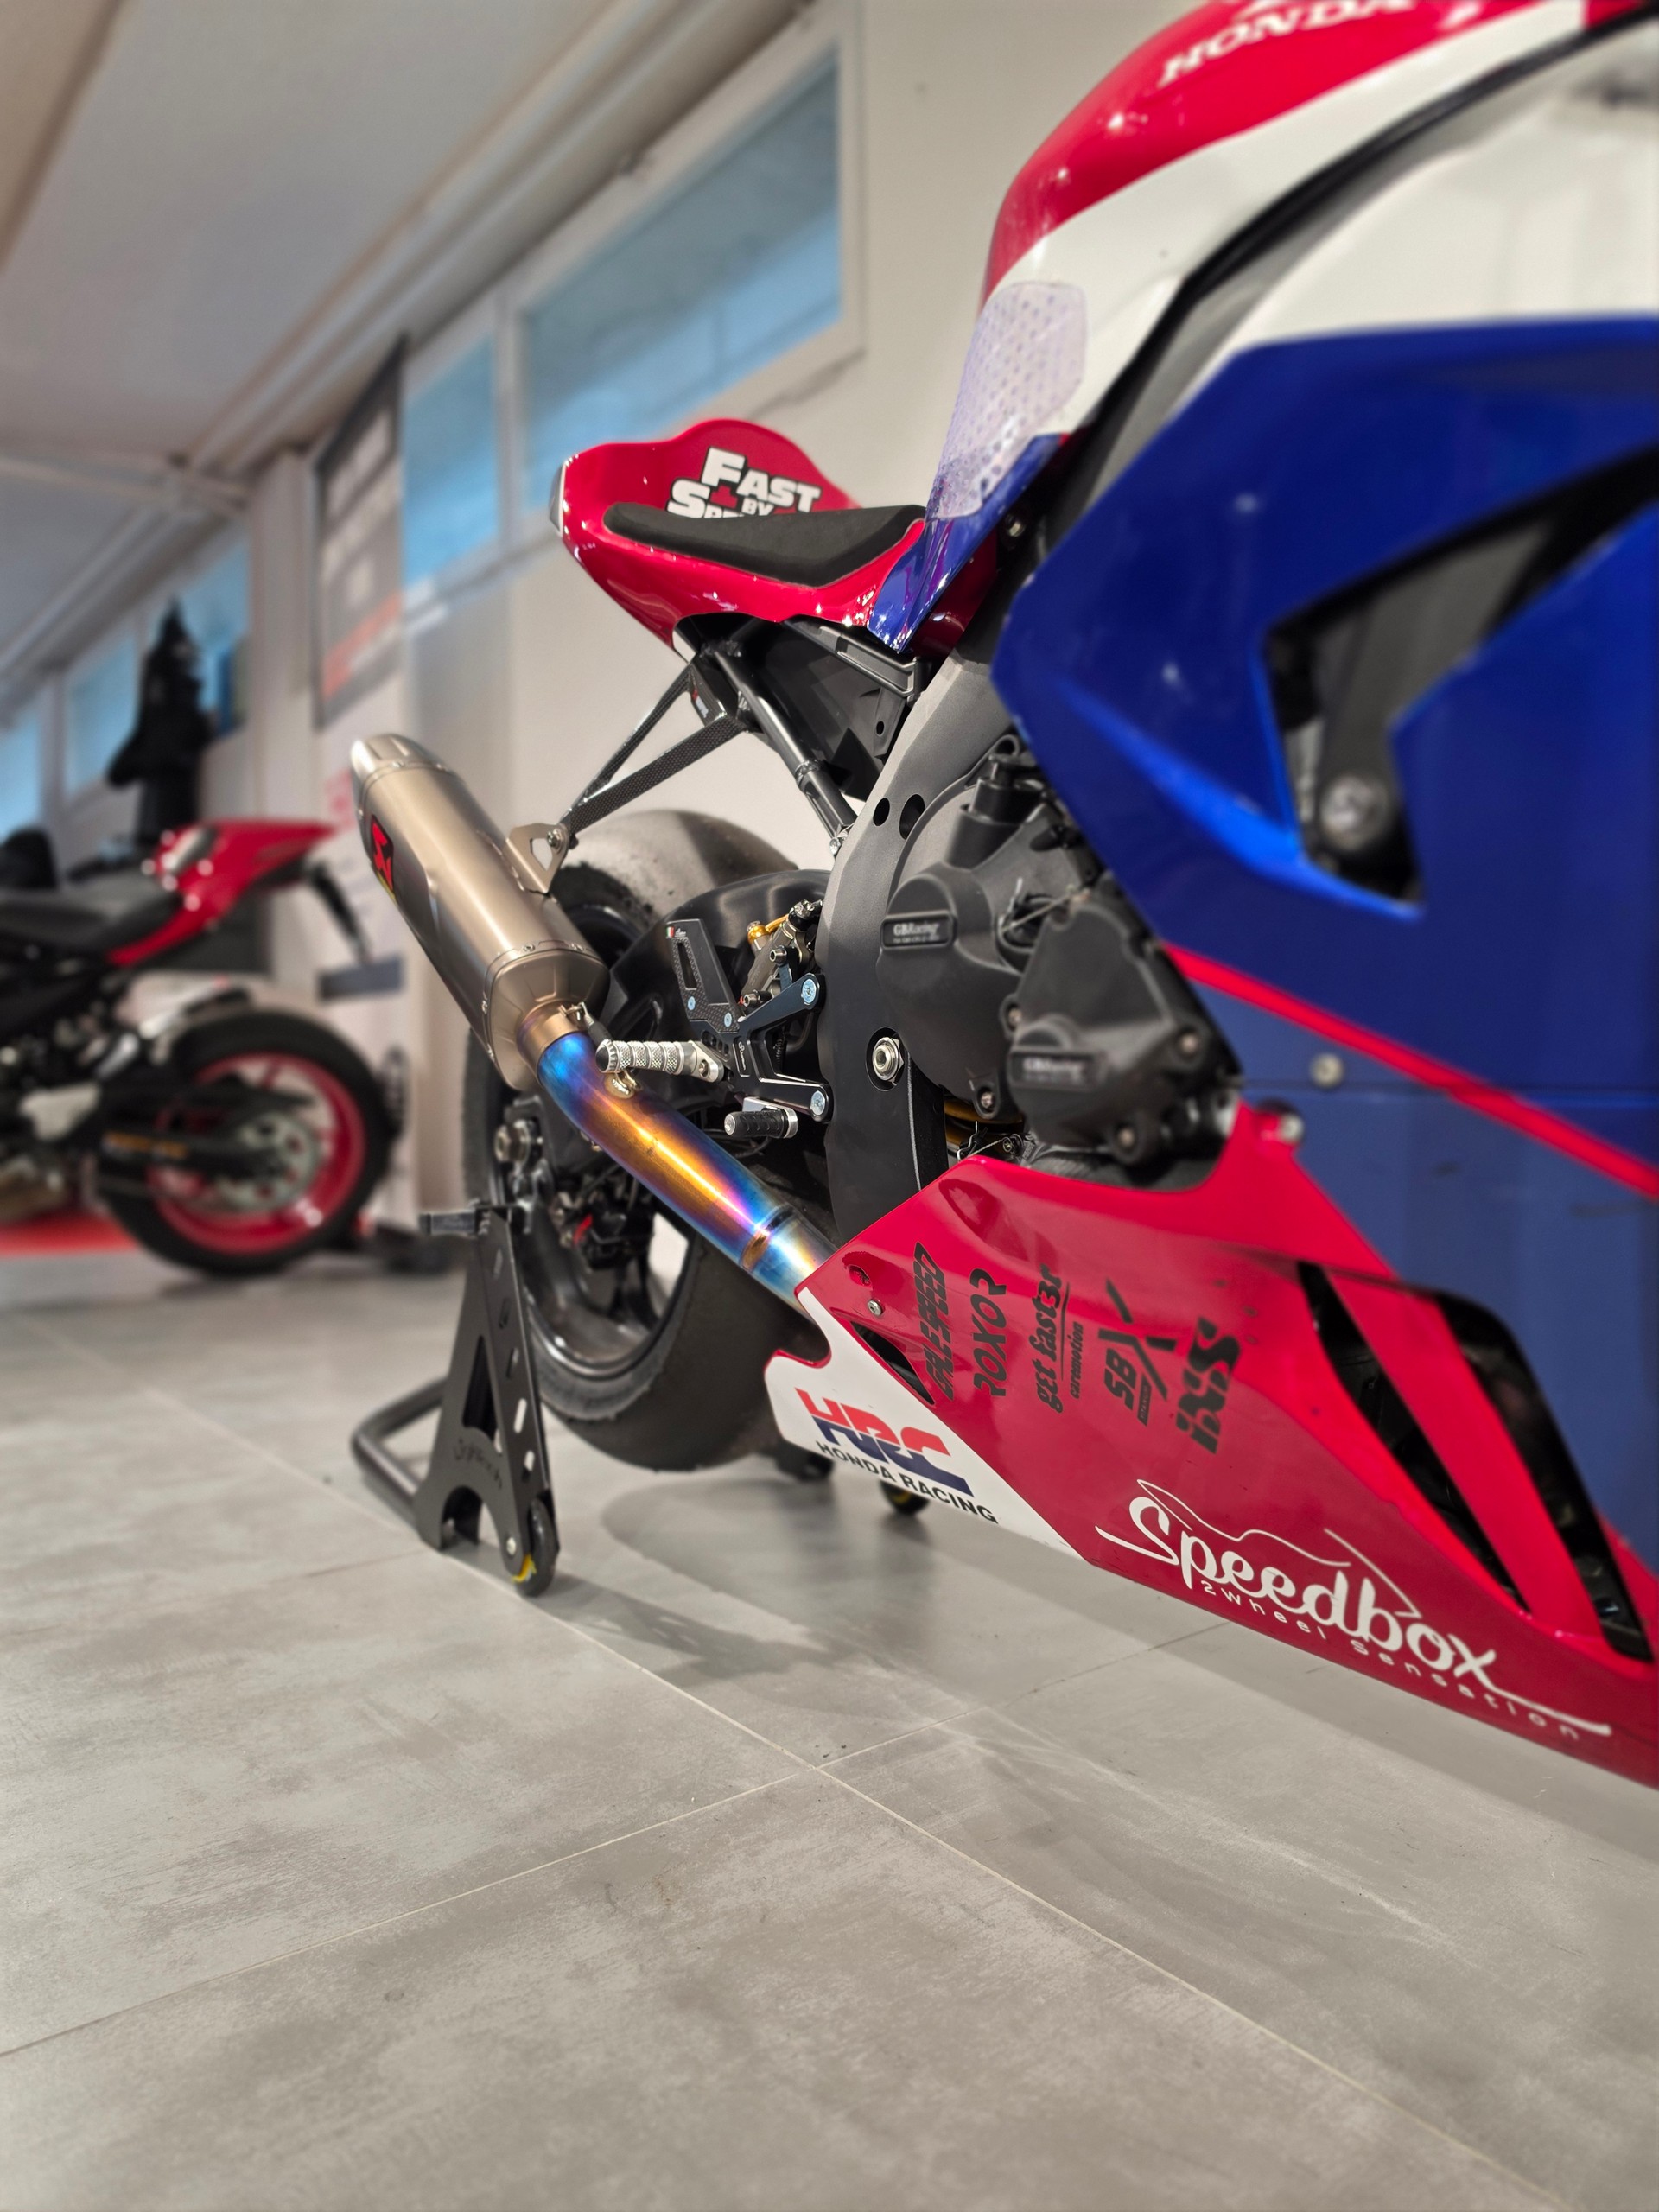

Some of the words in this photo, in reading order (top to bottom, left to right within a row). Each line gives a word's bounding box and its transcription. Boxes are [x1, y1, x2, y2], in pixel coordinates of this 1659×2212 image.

[701, 447, 822, 514] FAST
[741, 497, 774, 517] BY
[1067, 1321, 1084, 1399] caremotion
[794, 1387, 975, 1497] HRC
[815, 1440, 896, 1483] HONDA
[897, 1472, 999, 1524] RACING
[1094, 1496, 1611, 1736] Speedbox
